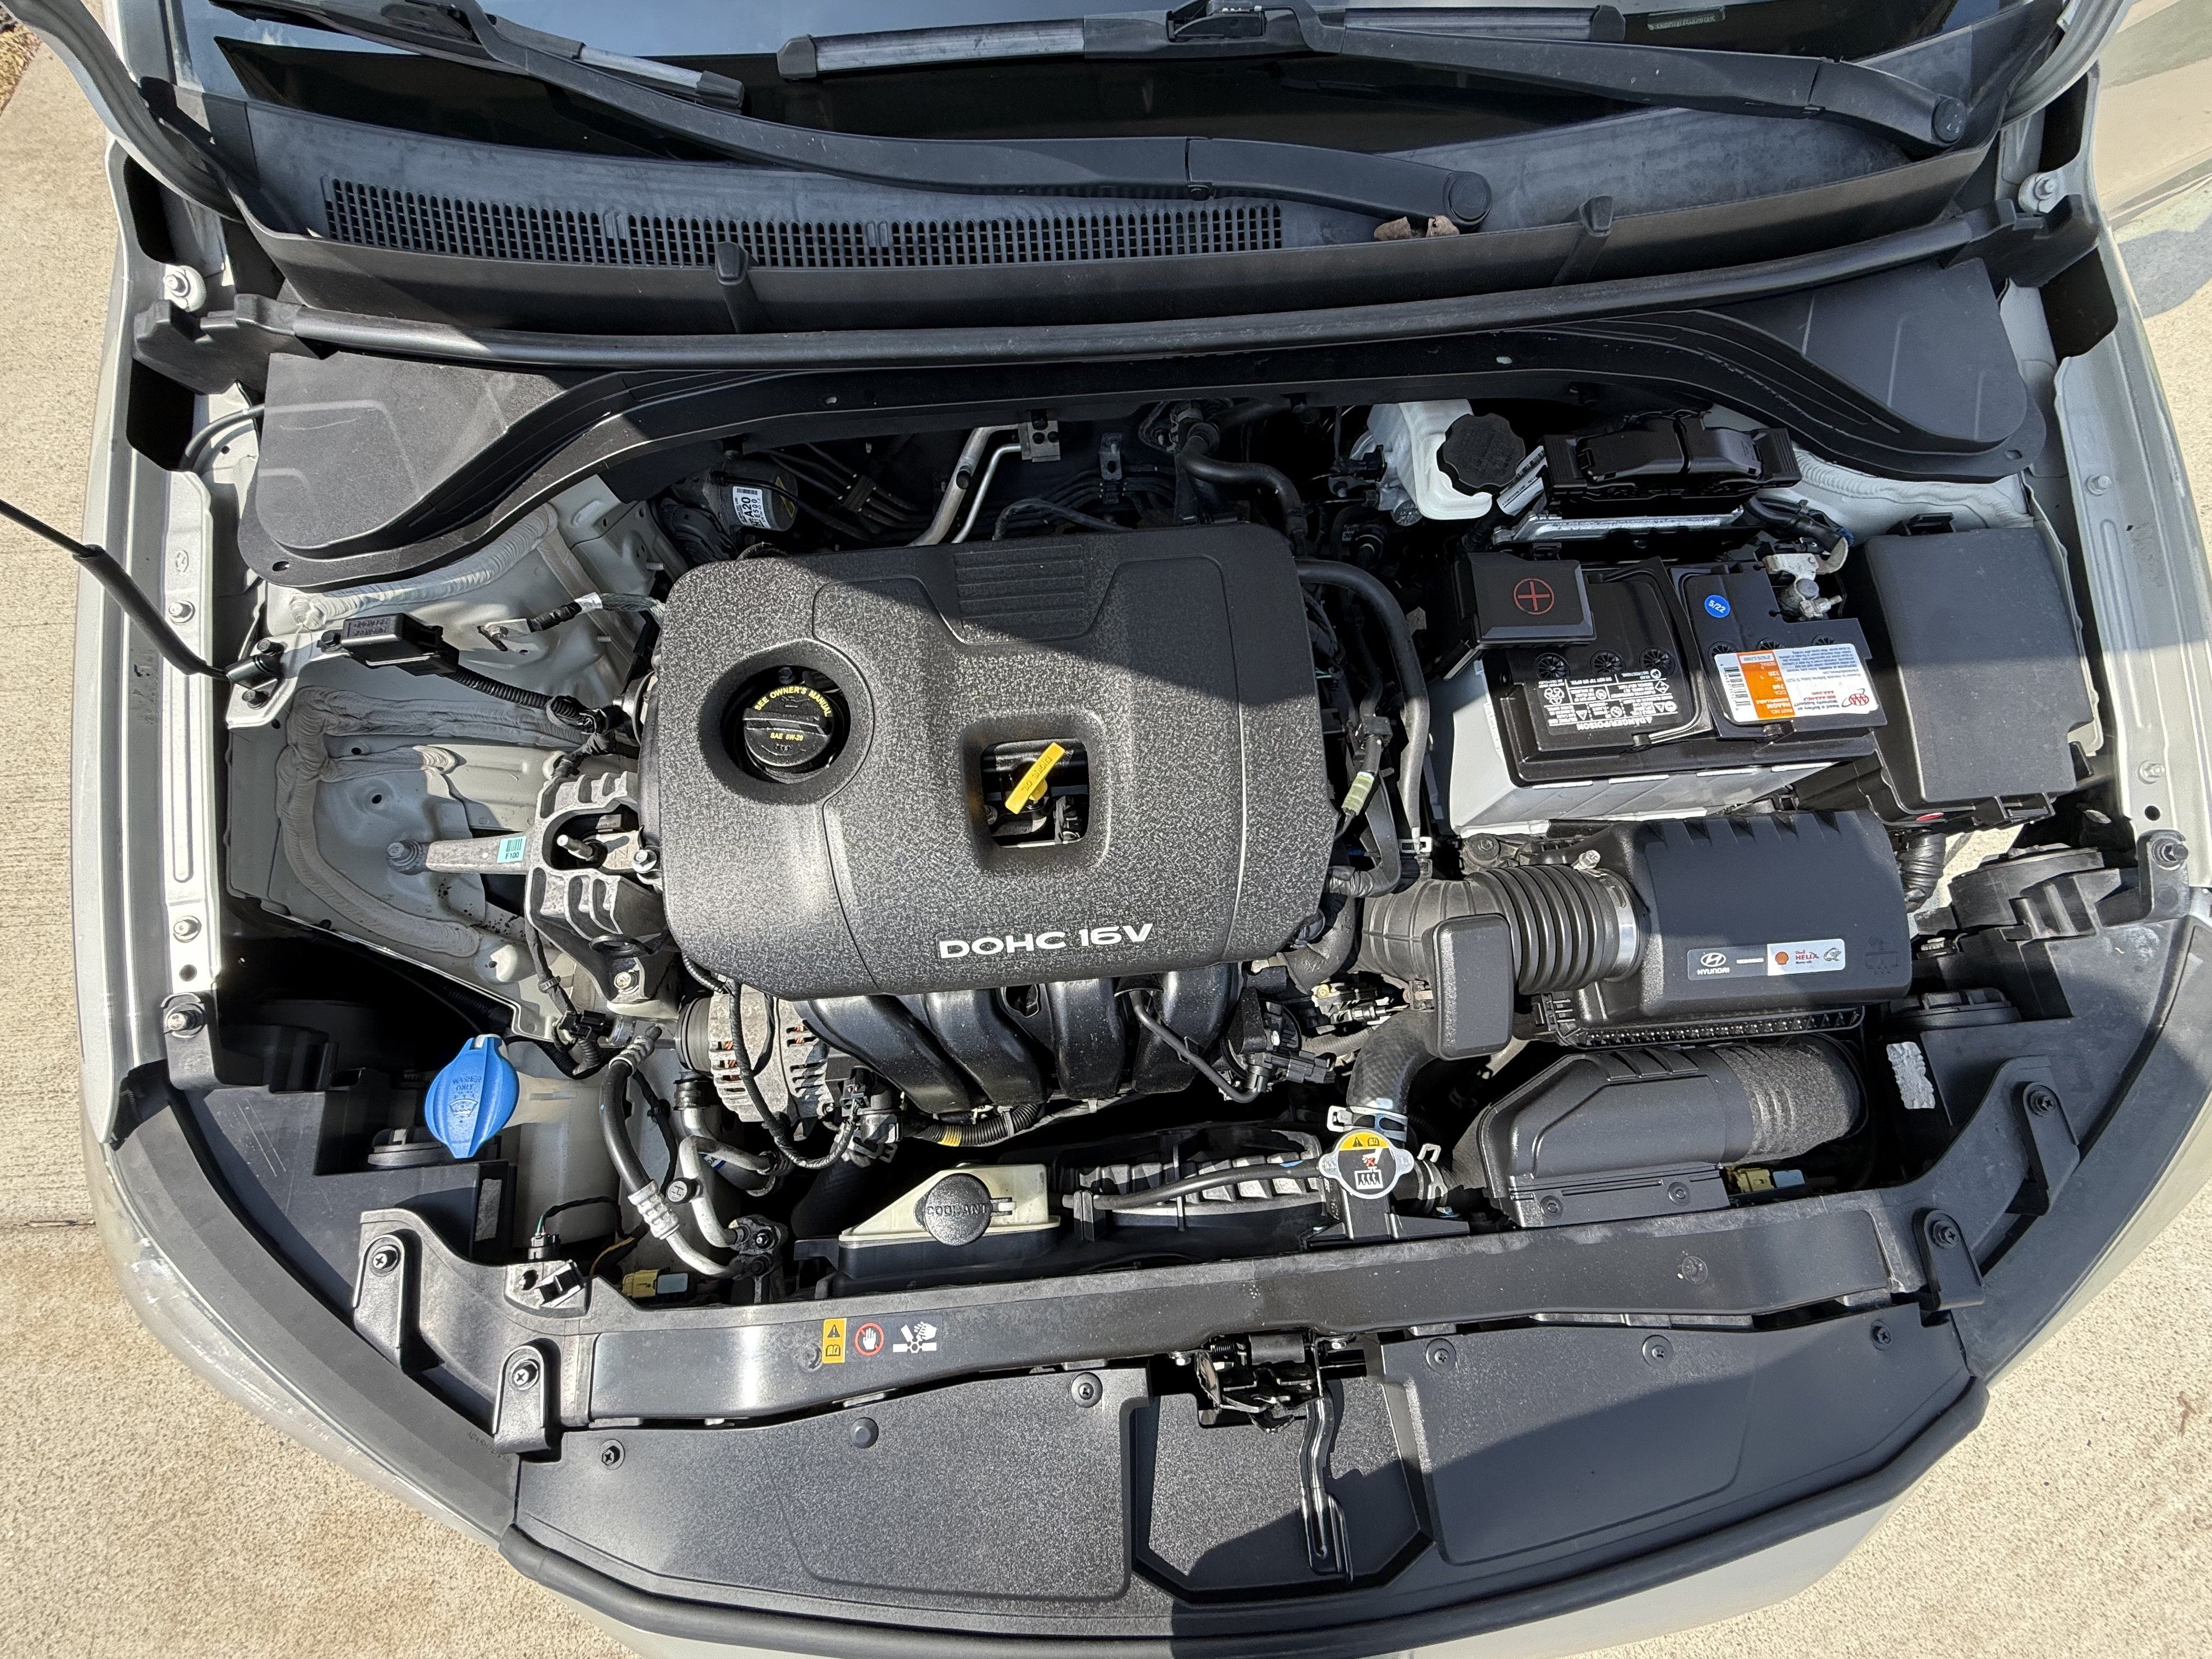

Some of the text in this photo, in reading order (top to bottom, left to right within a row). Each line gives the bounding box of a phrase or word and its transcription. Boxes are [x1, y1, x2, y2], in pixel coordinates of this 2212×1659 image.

[741, 496, 754, 518] A20
[752, 499, 760, 518] E500
[1708, 600, 1726, 614] 5/22
[754, 686, 832, 718] SEE OWNER'S MANUAL
[1850, 696, 1867, 705] AAA
[1576, 716, 1646, 730] DANGER/POISON
[785, 733, 804, 742] 5W-20
[1031, 756, 1053, 780] ENGINE
[1021, 780, 1033, 792] OIL
[505, 851, 520, 860] F100
[939, 923, 1153, 959] DOHC 16V
[1795, 952, 1820, 961] HELIX
[1697, 967, 1730, 976] HYUNDAI
[453, 1075, 482, 1085] WASHER
[926, 1204, 989, 1216] COOLANT
